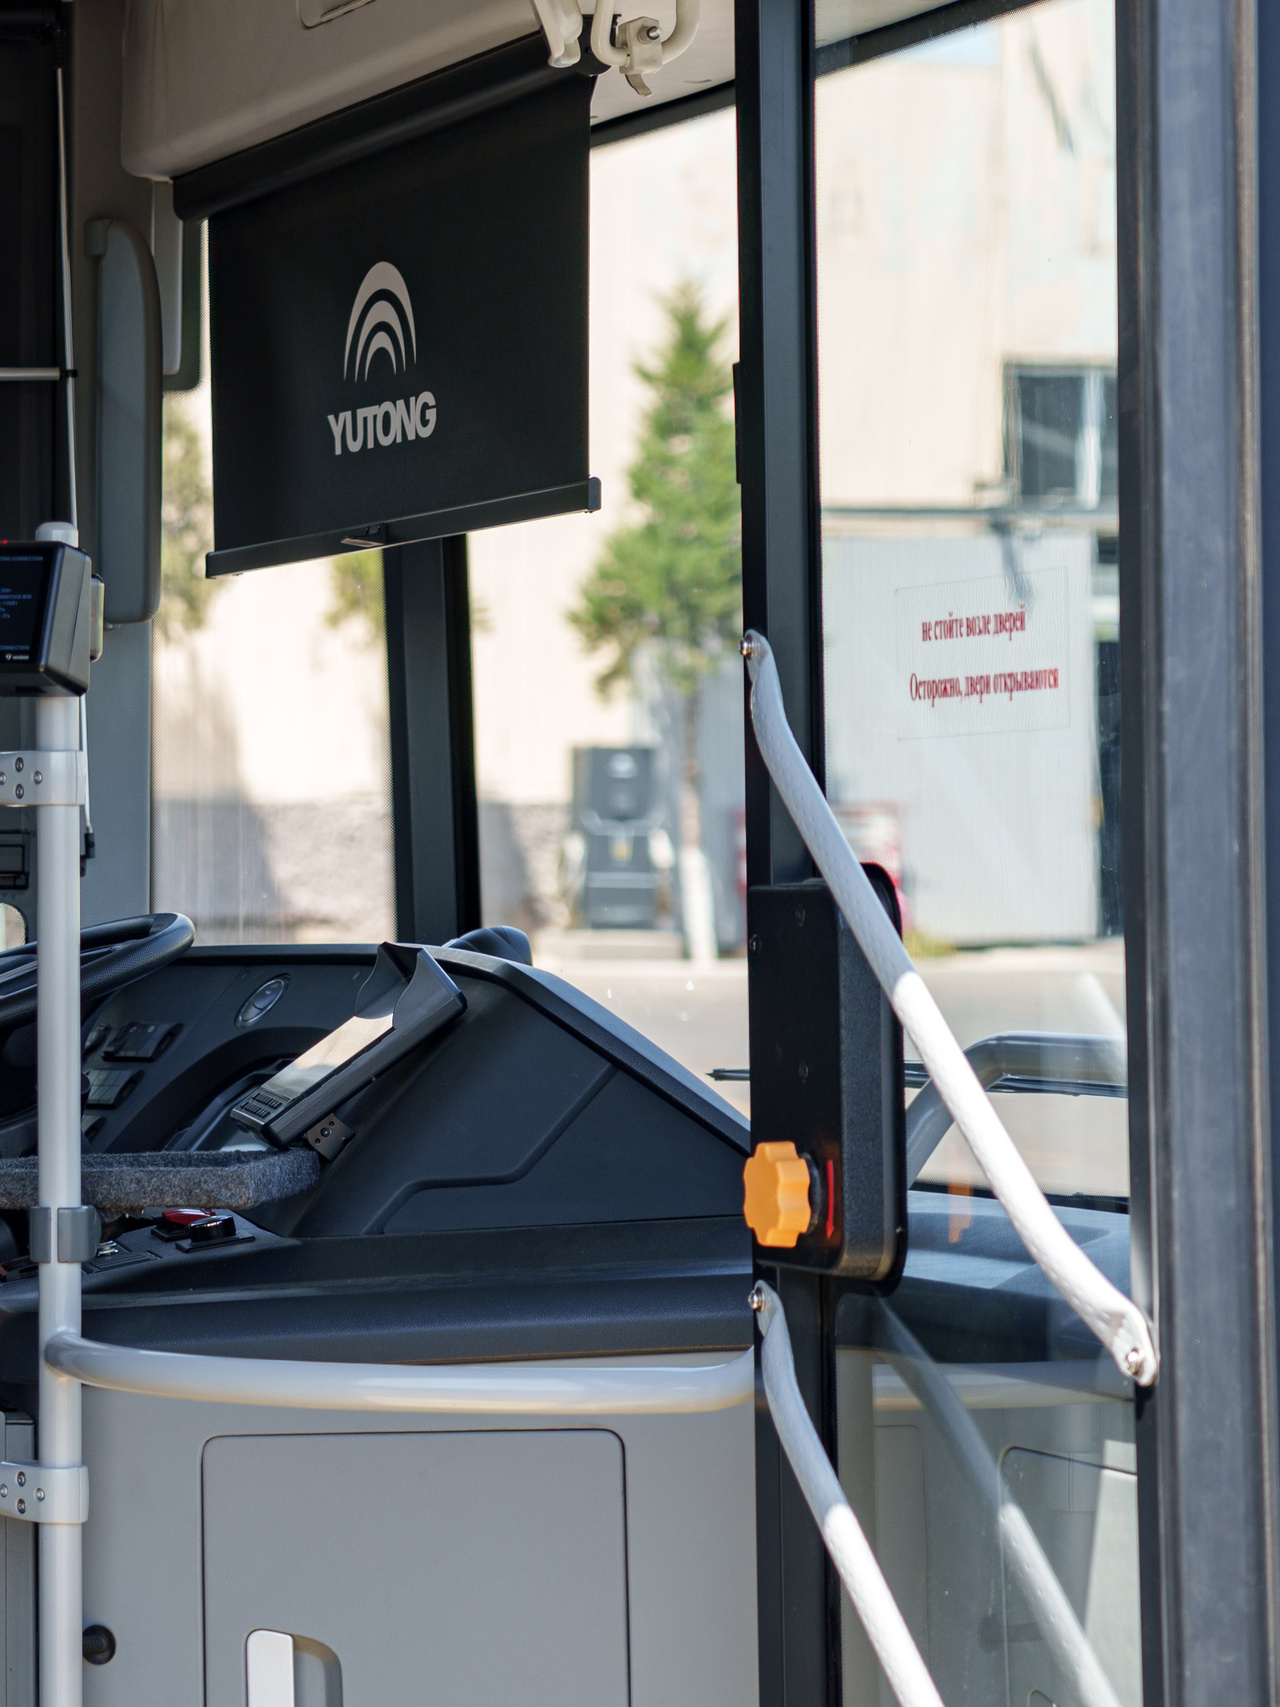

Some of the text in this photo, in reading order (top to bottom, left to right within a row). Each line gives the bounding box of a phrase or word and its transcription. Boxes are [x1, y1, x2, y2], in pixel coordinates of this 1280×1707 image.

[327, 391, 437, 456] YUTONG
[922, 604, 1026, 642] не стойте возле дверей
[910, 668, 1059, 707] Осторожно, двери открываются
